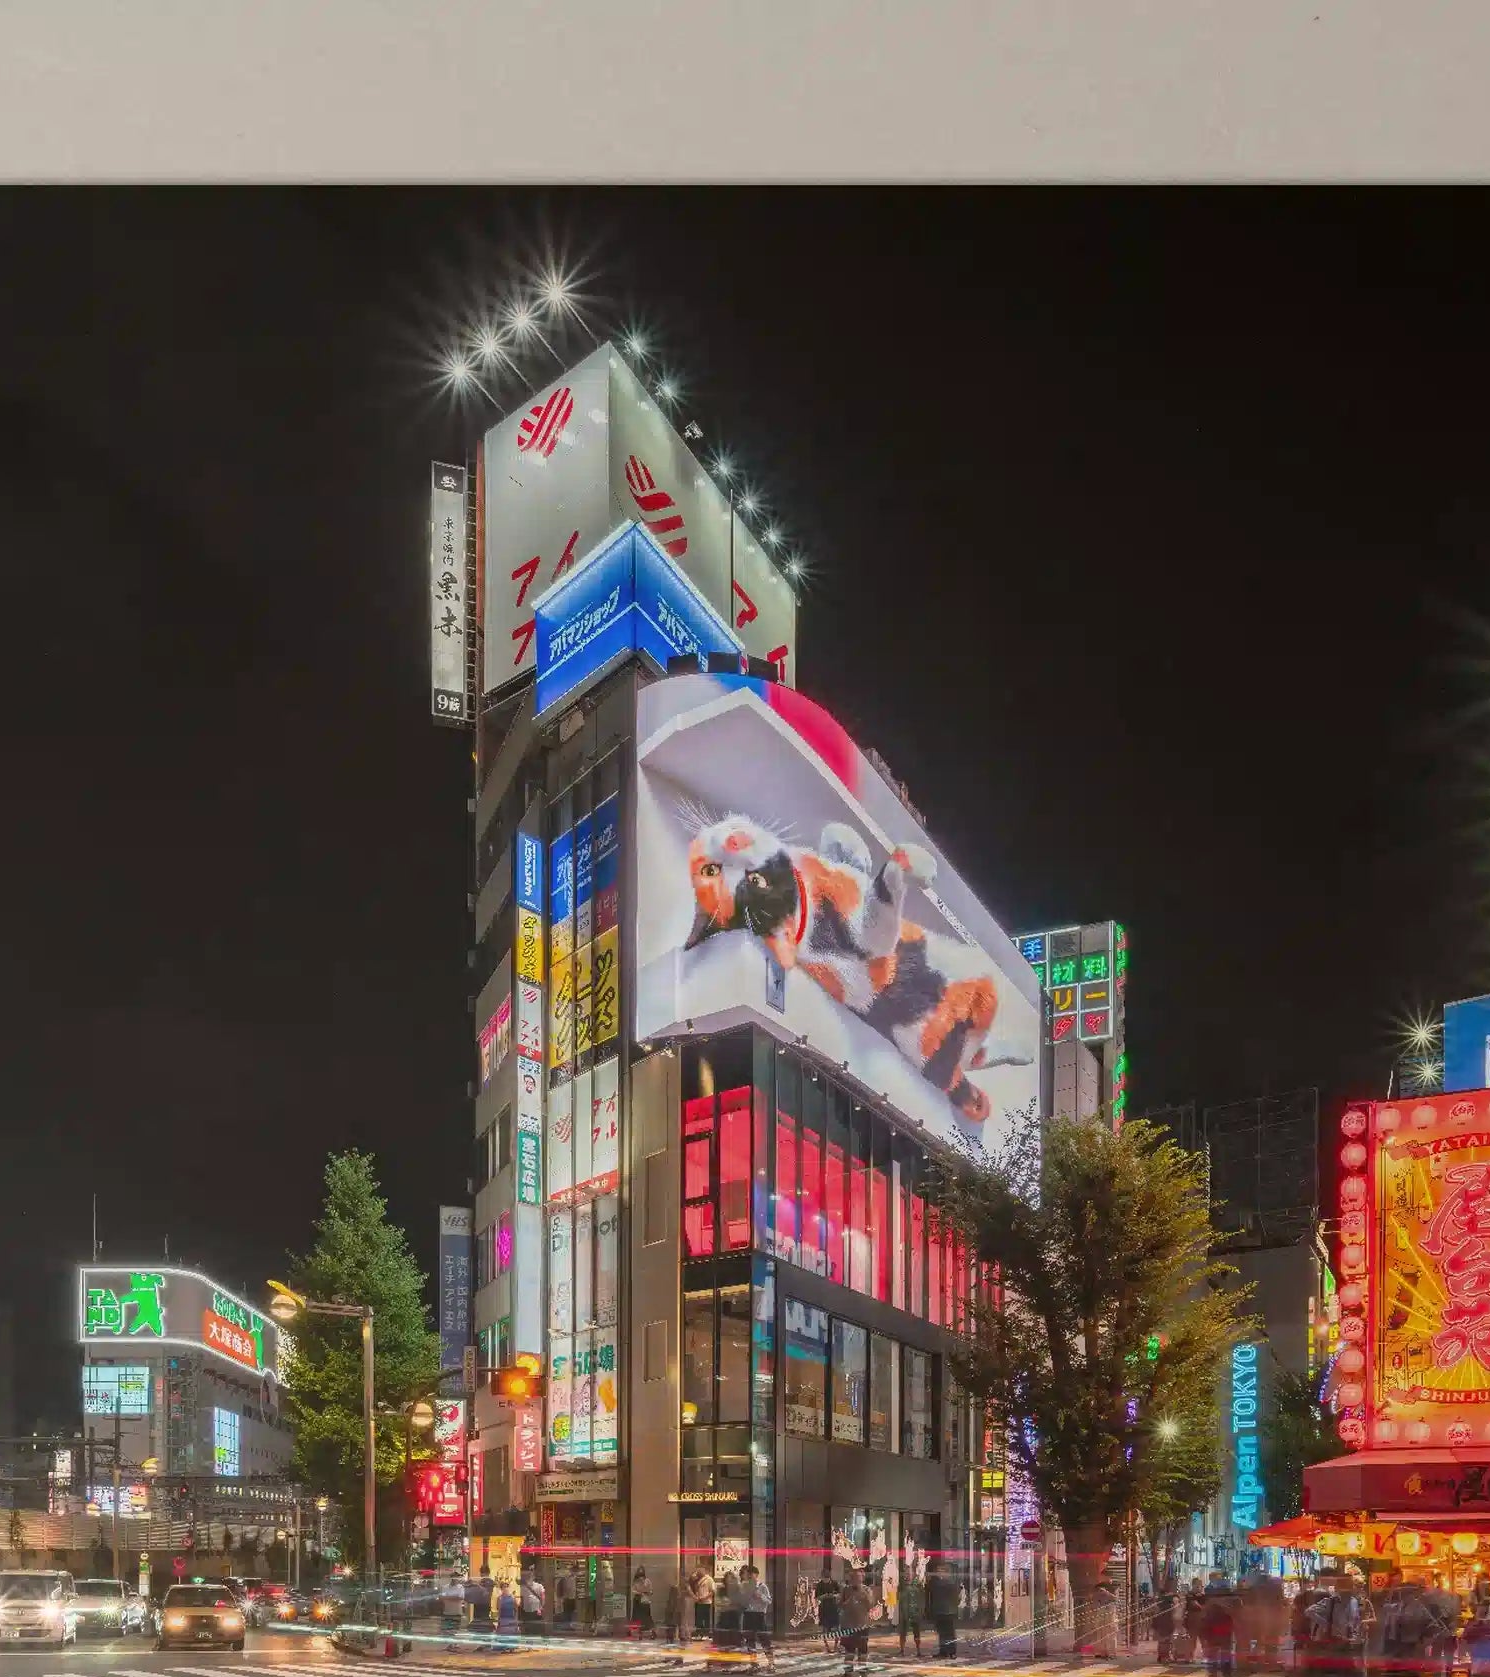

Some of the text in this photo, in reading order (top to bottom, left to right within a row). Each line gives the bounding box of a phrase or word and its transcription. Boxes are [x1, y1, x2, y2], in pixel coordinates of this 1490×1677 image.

[209, 1321, 253, 1358] 大塚商会
[1232, 1345, 1266, 1529] Alpen TOKYO
